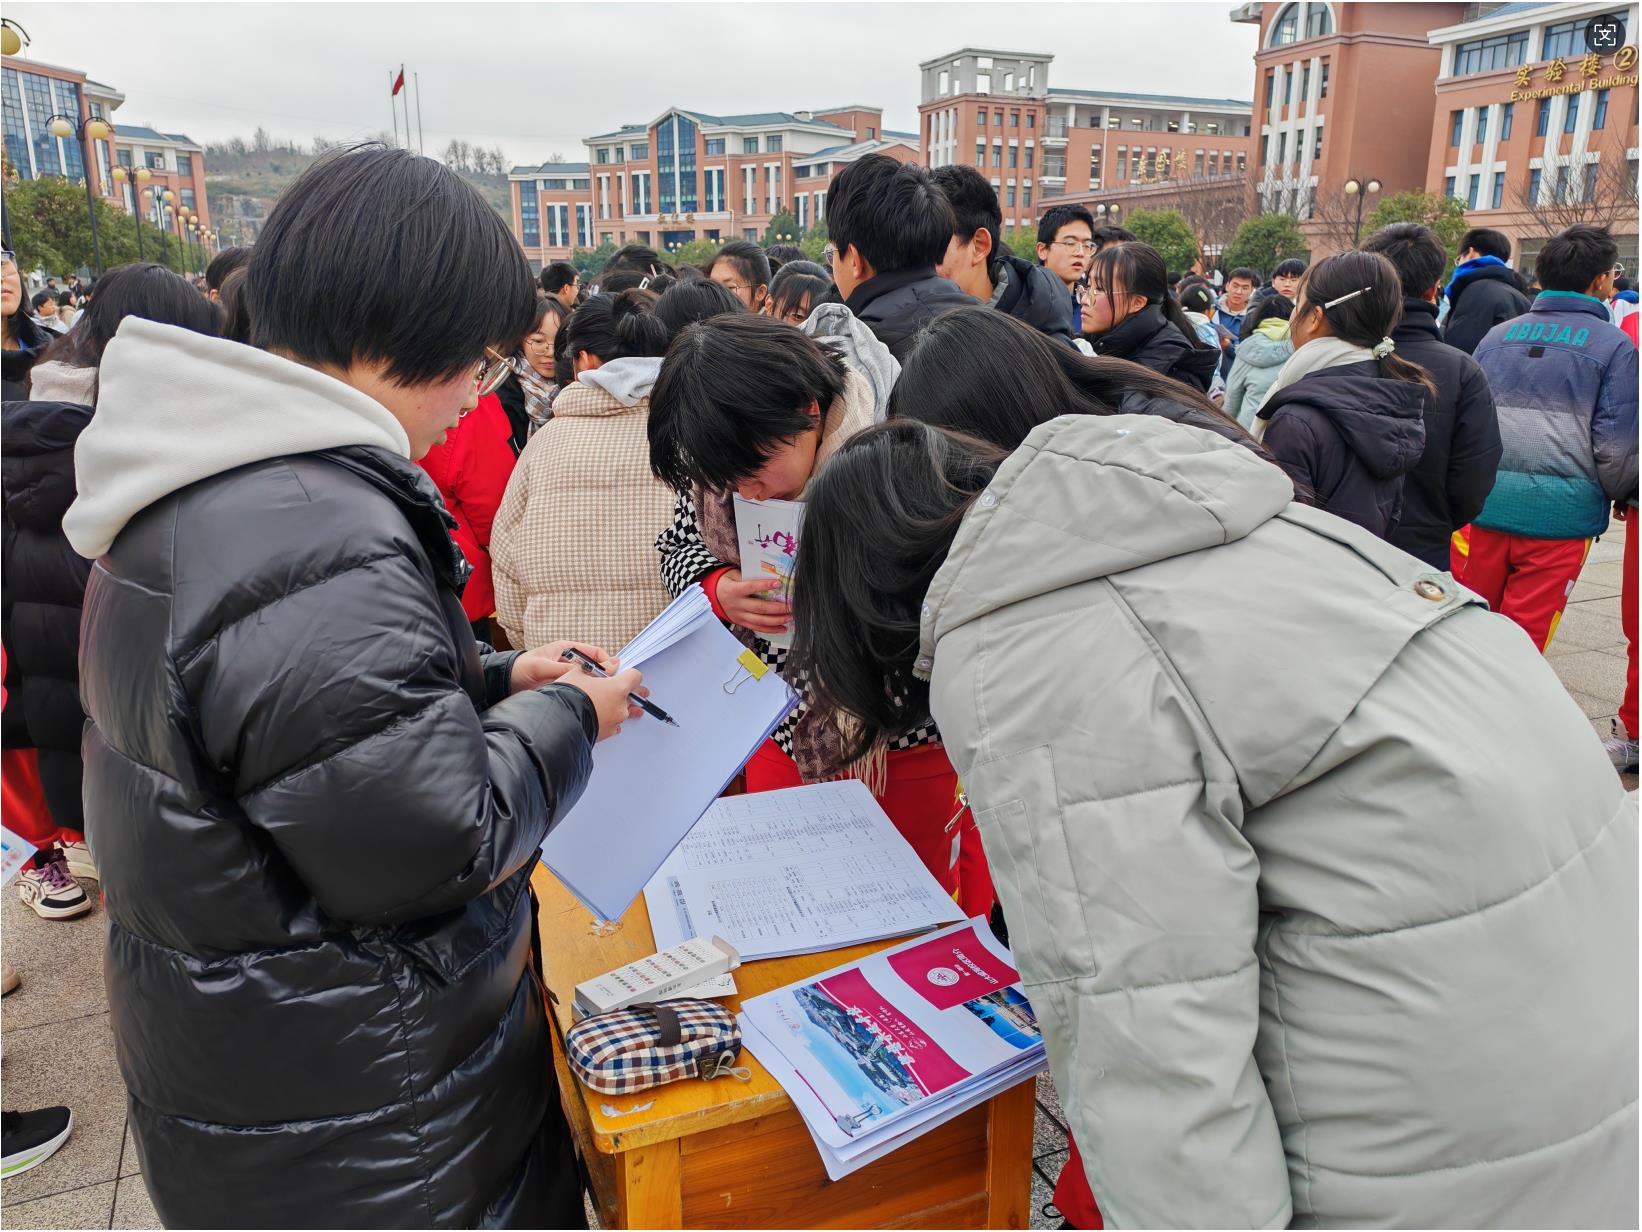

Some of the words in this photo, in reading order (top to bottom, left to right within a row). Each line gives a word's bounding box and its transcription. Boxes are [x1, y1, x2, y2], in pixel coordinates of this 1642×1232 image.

[1510, 82, 1585, 102] Experimental
[1589, 74, 1639, 90] Building
[1504, 322, 1590, 347] ABDJAA
